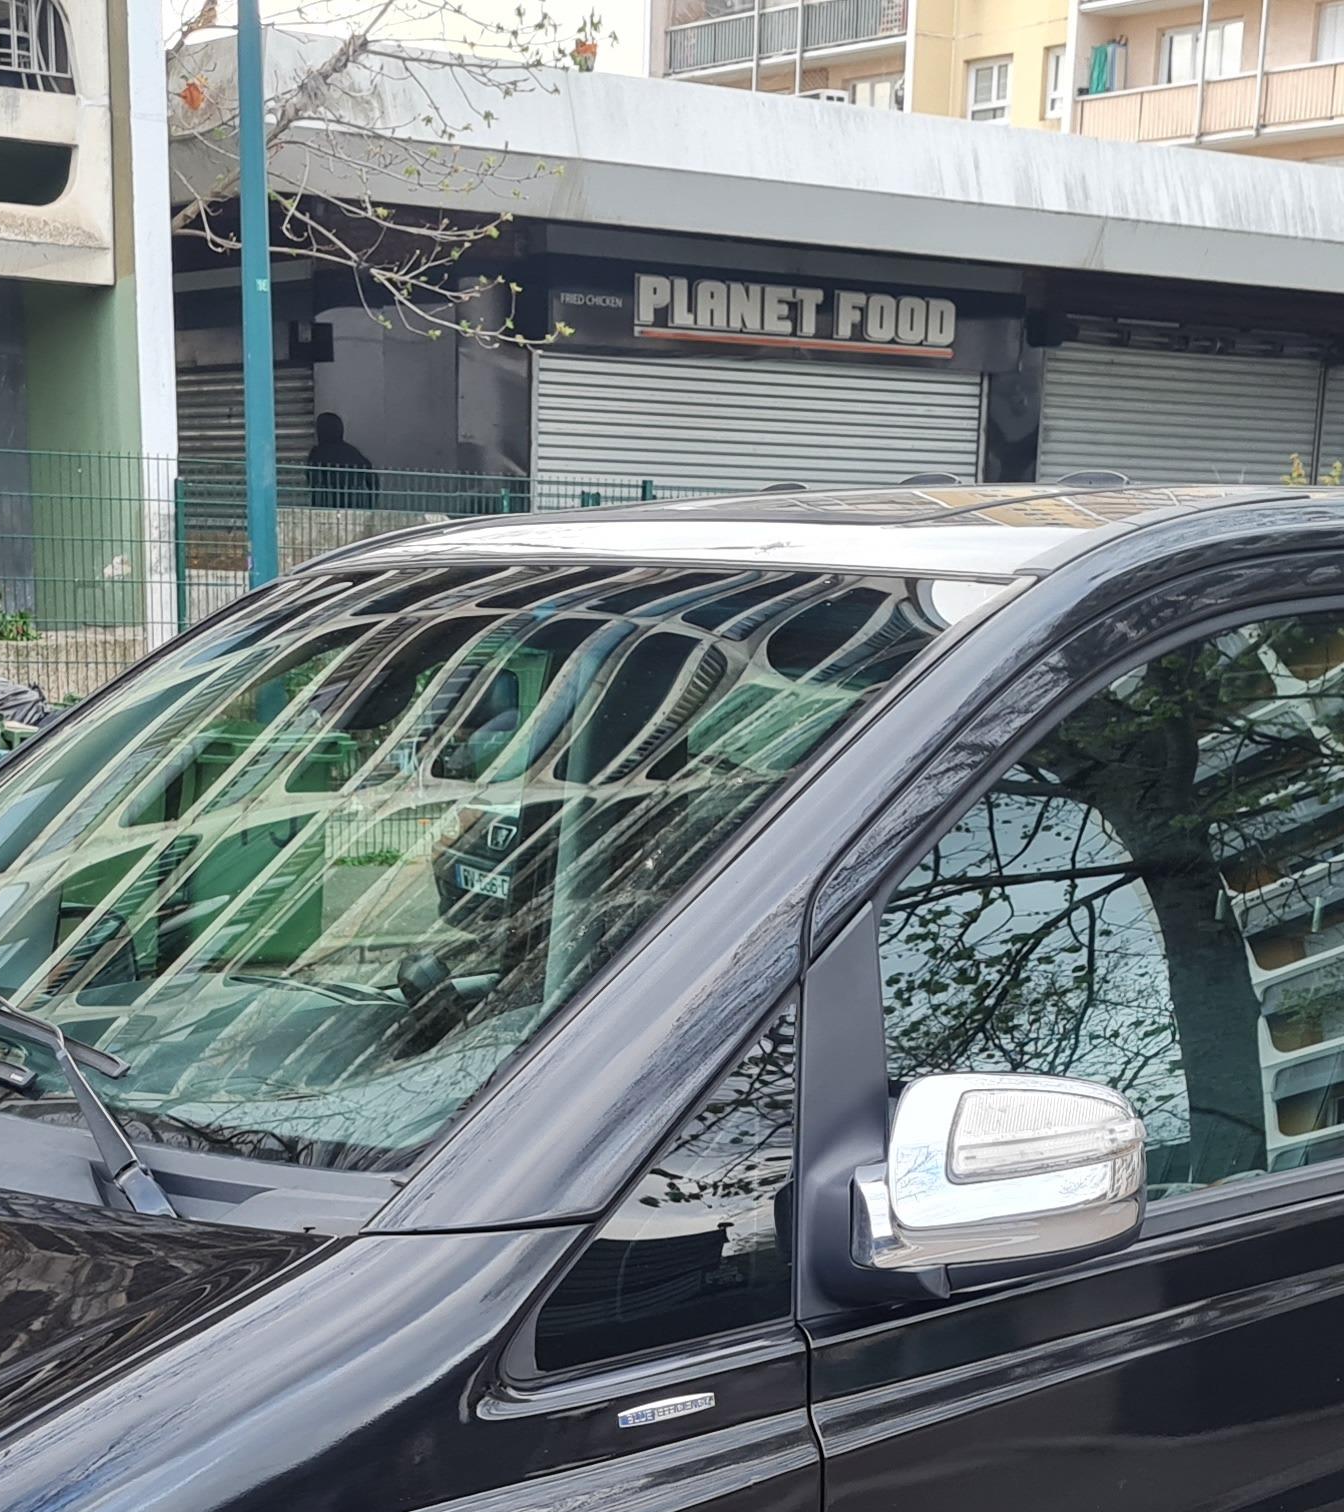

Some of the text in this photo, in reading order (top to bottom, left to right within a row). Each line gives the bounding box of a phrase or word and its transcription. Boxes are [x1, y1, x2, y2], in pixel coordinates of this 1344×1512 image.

[560, 292, 623, 308] FRIED CHICKEN
[634, 273, 956, 346] PLANET FOOD
